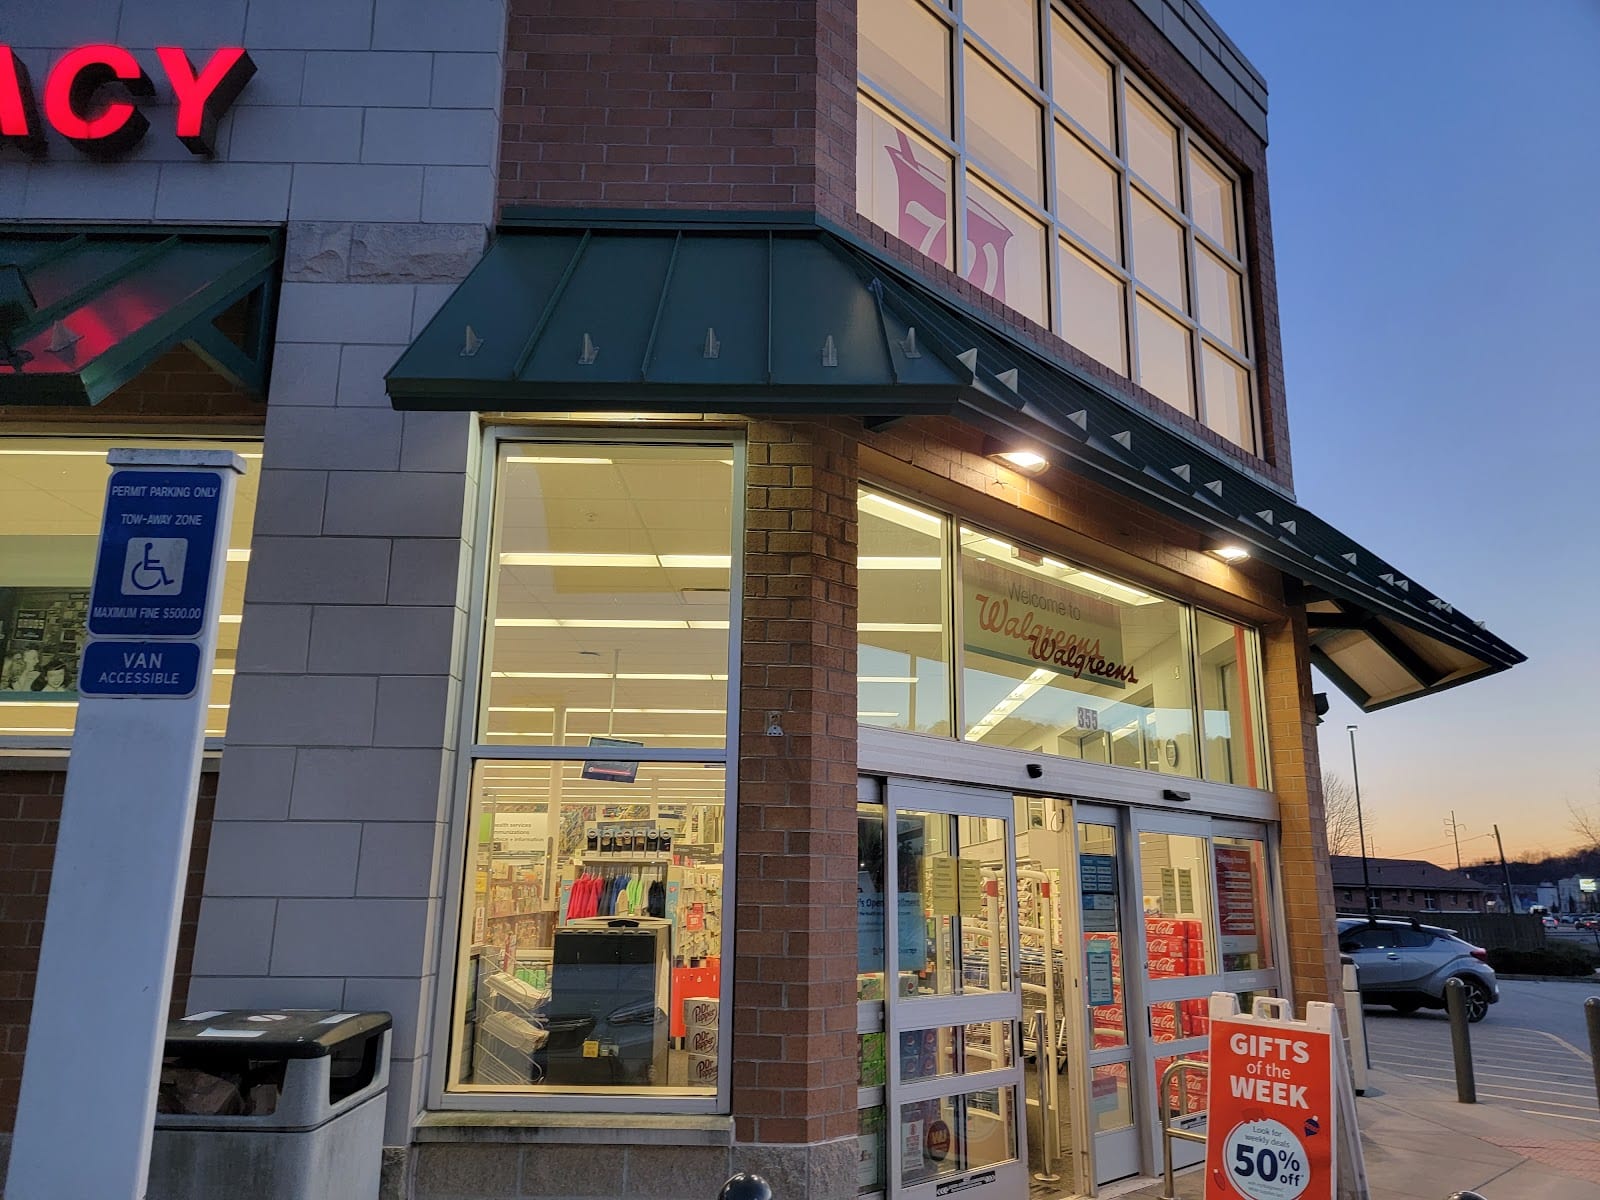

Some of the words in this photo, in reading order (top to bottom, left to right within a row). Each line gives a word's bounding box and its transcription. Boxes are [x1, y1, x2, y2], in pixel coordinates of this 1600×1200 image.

[112, 486, 146, 497] PERMIT
[150, 486, 191, 498] PARKING
[194, 487, 218, 498] ONLY
[121, 513, 172, 525] TOW-AWAY
[175, 514, 202, 526] ZONE
[1007, 582, 1065, 616] Welcome
[1069, 604, 1081, 621] to
[93, 607, 137, 619] MAXIMUM
[140, 607, 159, 619] FINE
[976, 593, 1104, 659] Walgreens
[123, 652, 163, 669] VAN
[1029, 633, 1139, 684] Walgreens
[98, 672, 180, 684] ACCESSIBLE
[1077, 708, 1098, 730] 355
[1230, 1033, 1310, 1064] GIFTS
[1246, 1060, 1262, 1075] of
[1265, 1062, 1291, 1080] the
[1230, 1075, 1310, 1109] WEEK
[1252, 1125, 1270, 1135] Look
[1271, 1128, 1283, 1137] for
[1244, 1134, 1270, 1146] weekly
[1270, 1138, 1290, 1149] deals
[1234, 1143, 1300, 1182] 50%
